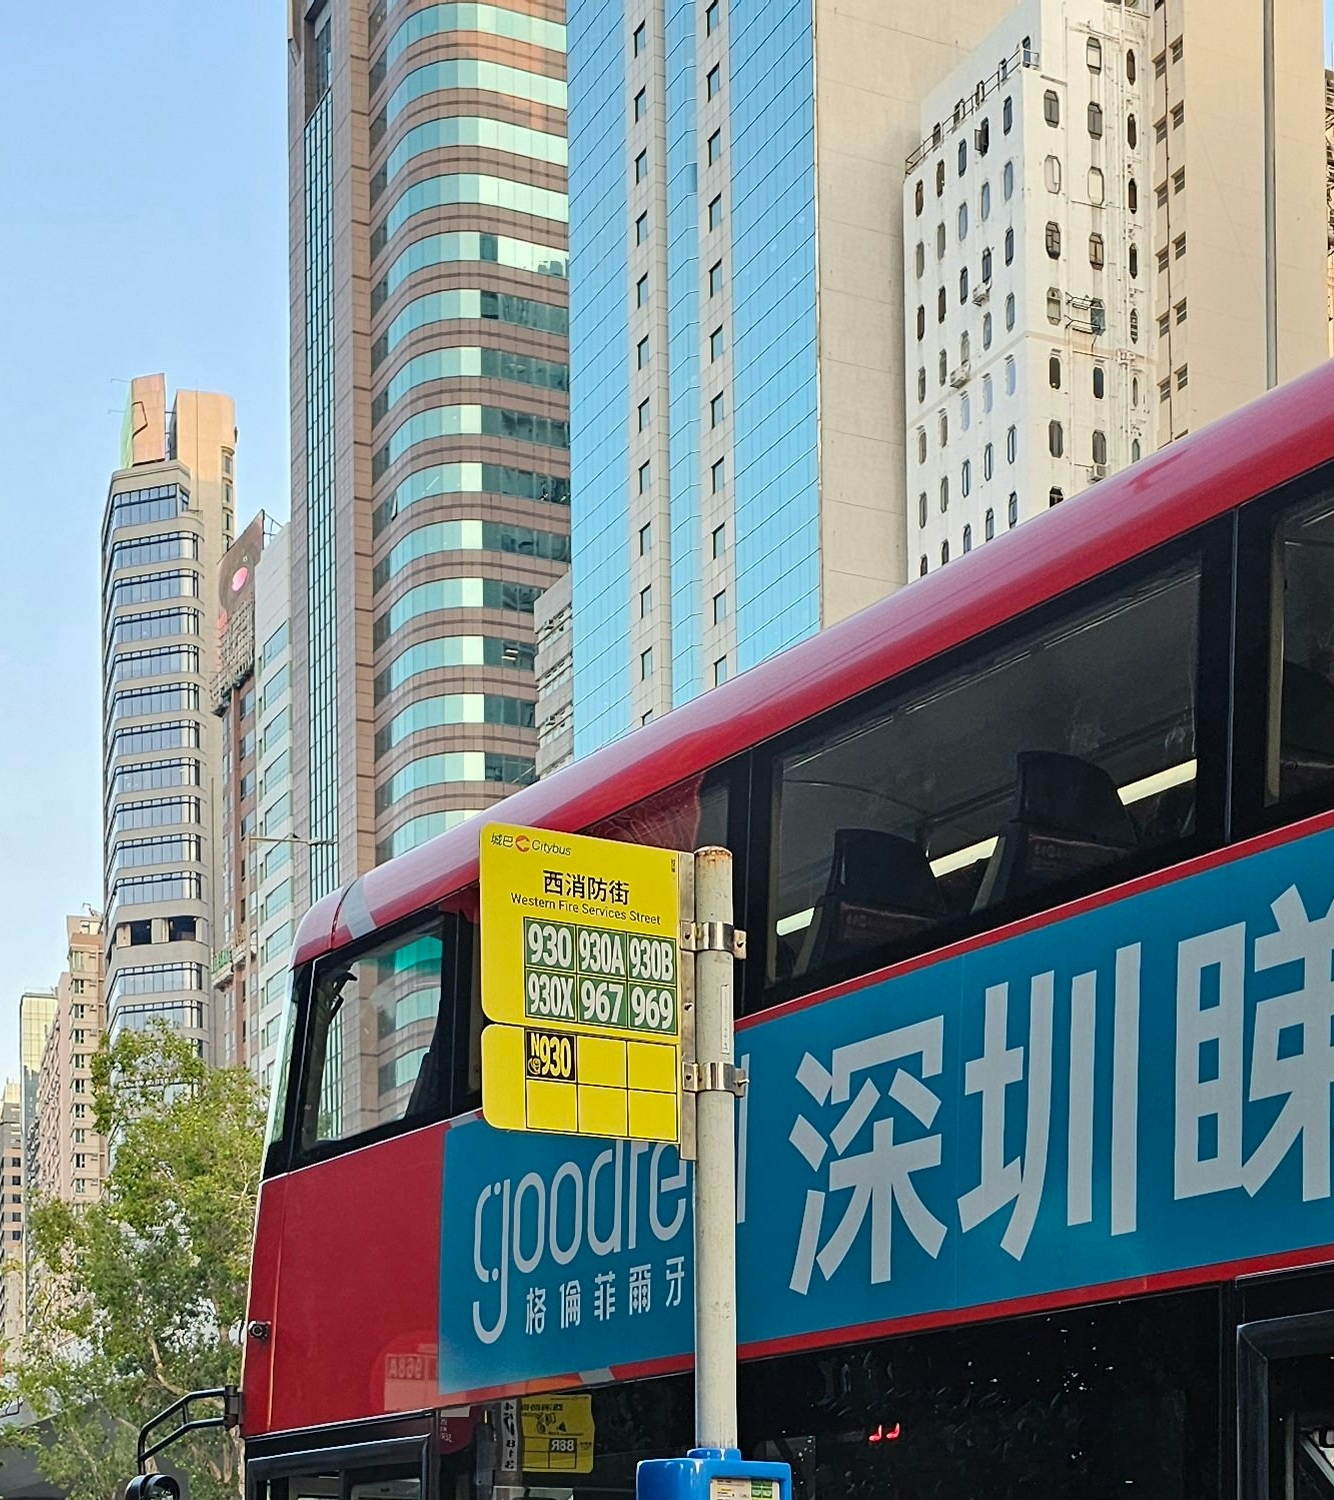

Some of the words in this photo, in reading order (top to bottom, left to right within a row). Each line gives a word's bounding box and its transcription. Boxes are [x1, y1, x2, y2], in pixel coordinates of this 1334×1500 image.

[491, 834, 514, 848] 城巴
[531, 840, 572, 857] Citybus
[511, 892, 556, 912] Western
[558, 900, 579, 914] Fire
[581, 904, 627, 921] Services
[629, 910, 661, 926] Street
[542, 869, 630, 906] 西消防街
[528, 923, 573, 967] 930
[579, 930, 625, 975] 930A
[630, 937, 673, 982] 930B
[528, 973, 574, 1019] 930X
[582, 980, 624, 1025] 967
[631, 986, 674, 1030] 969
[530, 1032, 572, 1079] N930
[525, 1255, 685, 1336] 格倫菲爾牙
